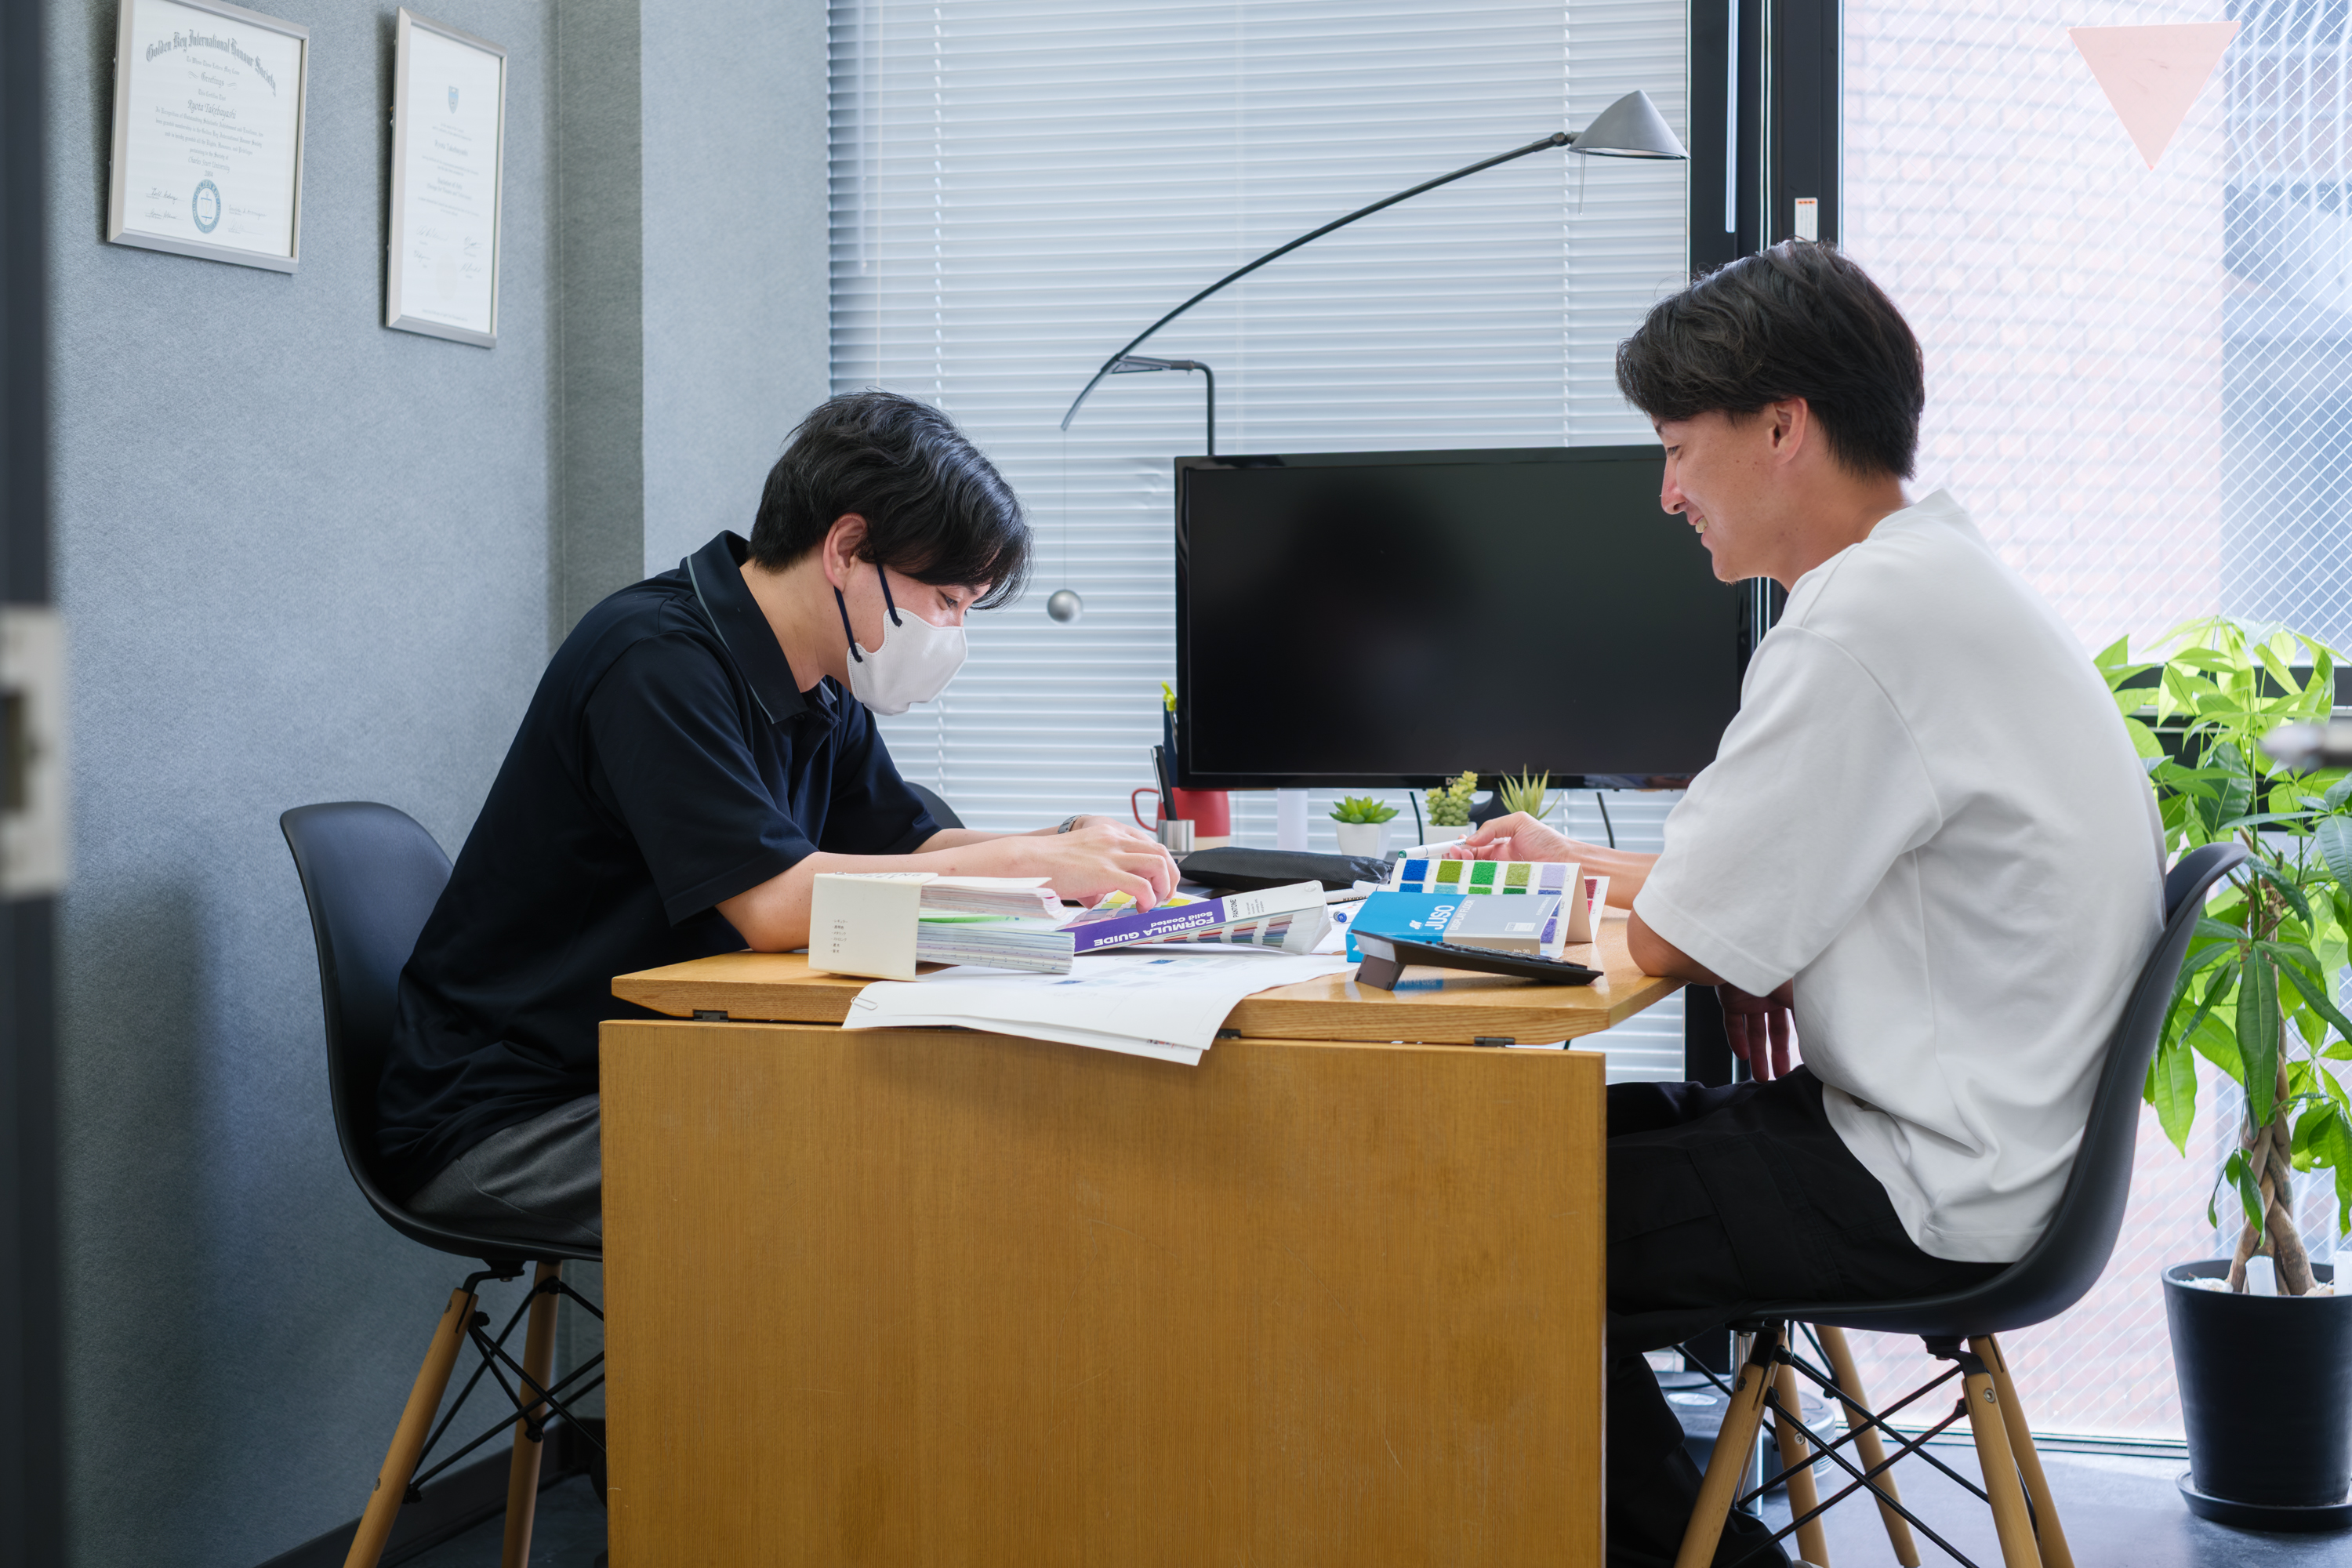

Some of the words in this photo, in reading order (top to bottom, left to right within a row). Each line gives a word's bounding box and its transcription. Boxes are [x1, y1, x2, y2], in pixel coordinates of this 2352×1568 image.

[147, 40, 172, 63] Golden
[173, 31, 187, 53] Key
[188, 29, 230, 53] International
[231, 38, 254, 68] Honour
[255, 56, 277, 97] Society
[201, 71, 225, 89] Greetings
[187, 99, 204, 114] Ryota
[205, 103, 237, 121] Takebayashi
[1188, 911, 1214, 921] Solid
[1230, 899, 1240, 918] PANTONE
[1425, 905, 1455, 930] JUSO
[1449, 913, 1467, 931] DISPLAY
[1459, 899, 1475, 913] FLOOR
[1143, 916, 1214, 937] FORMULA
[1150, 916, 1186, 928] Coated
[1094, 932, 1140, 947] GUIDE
